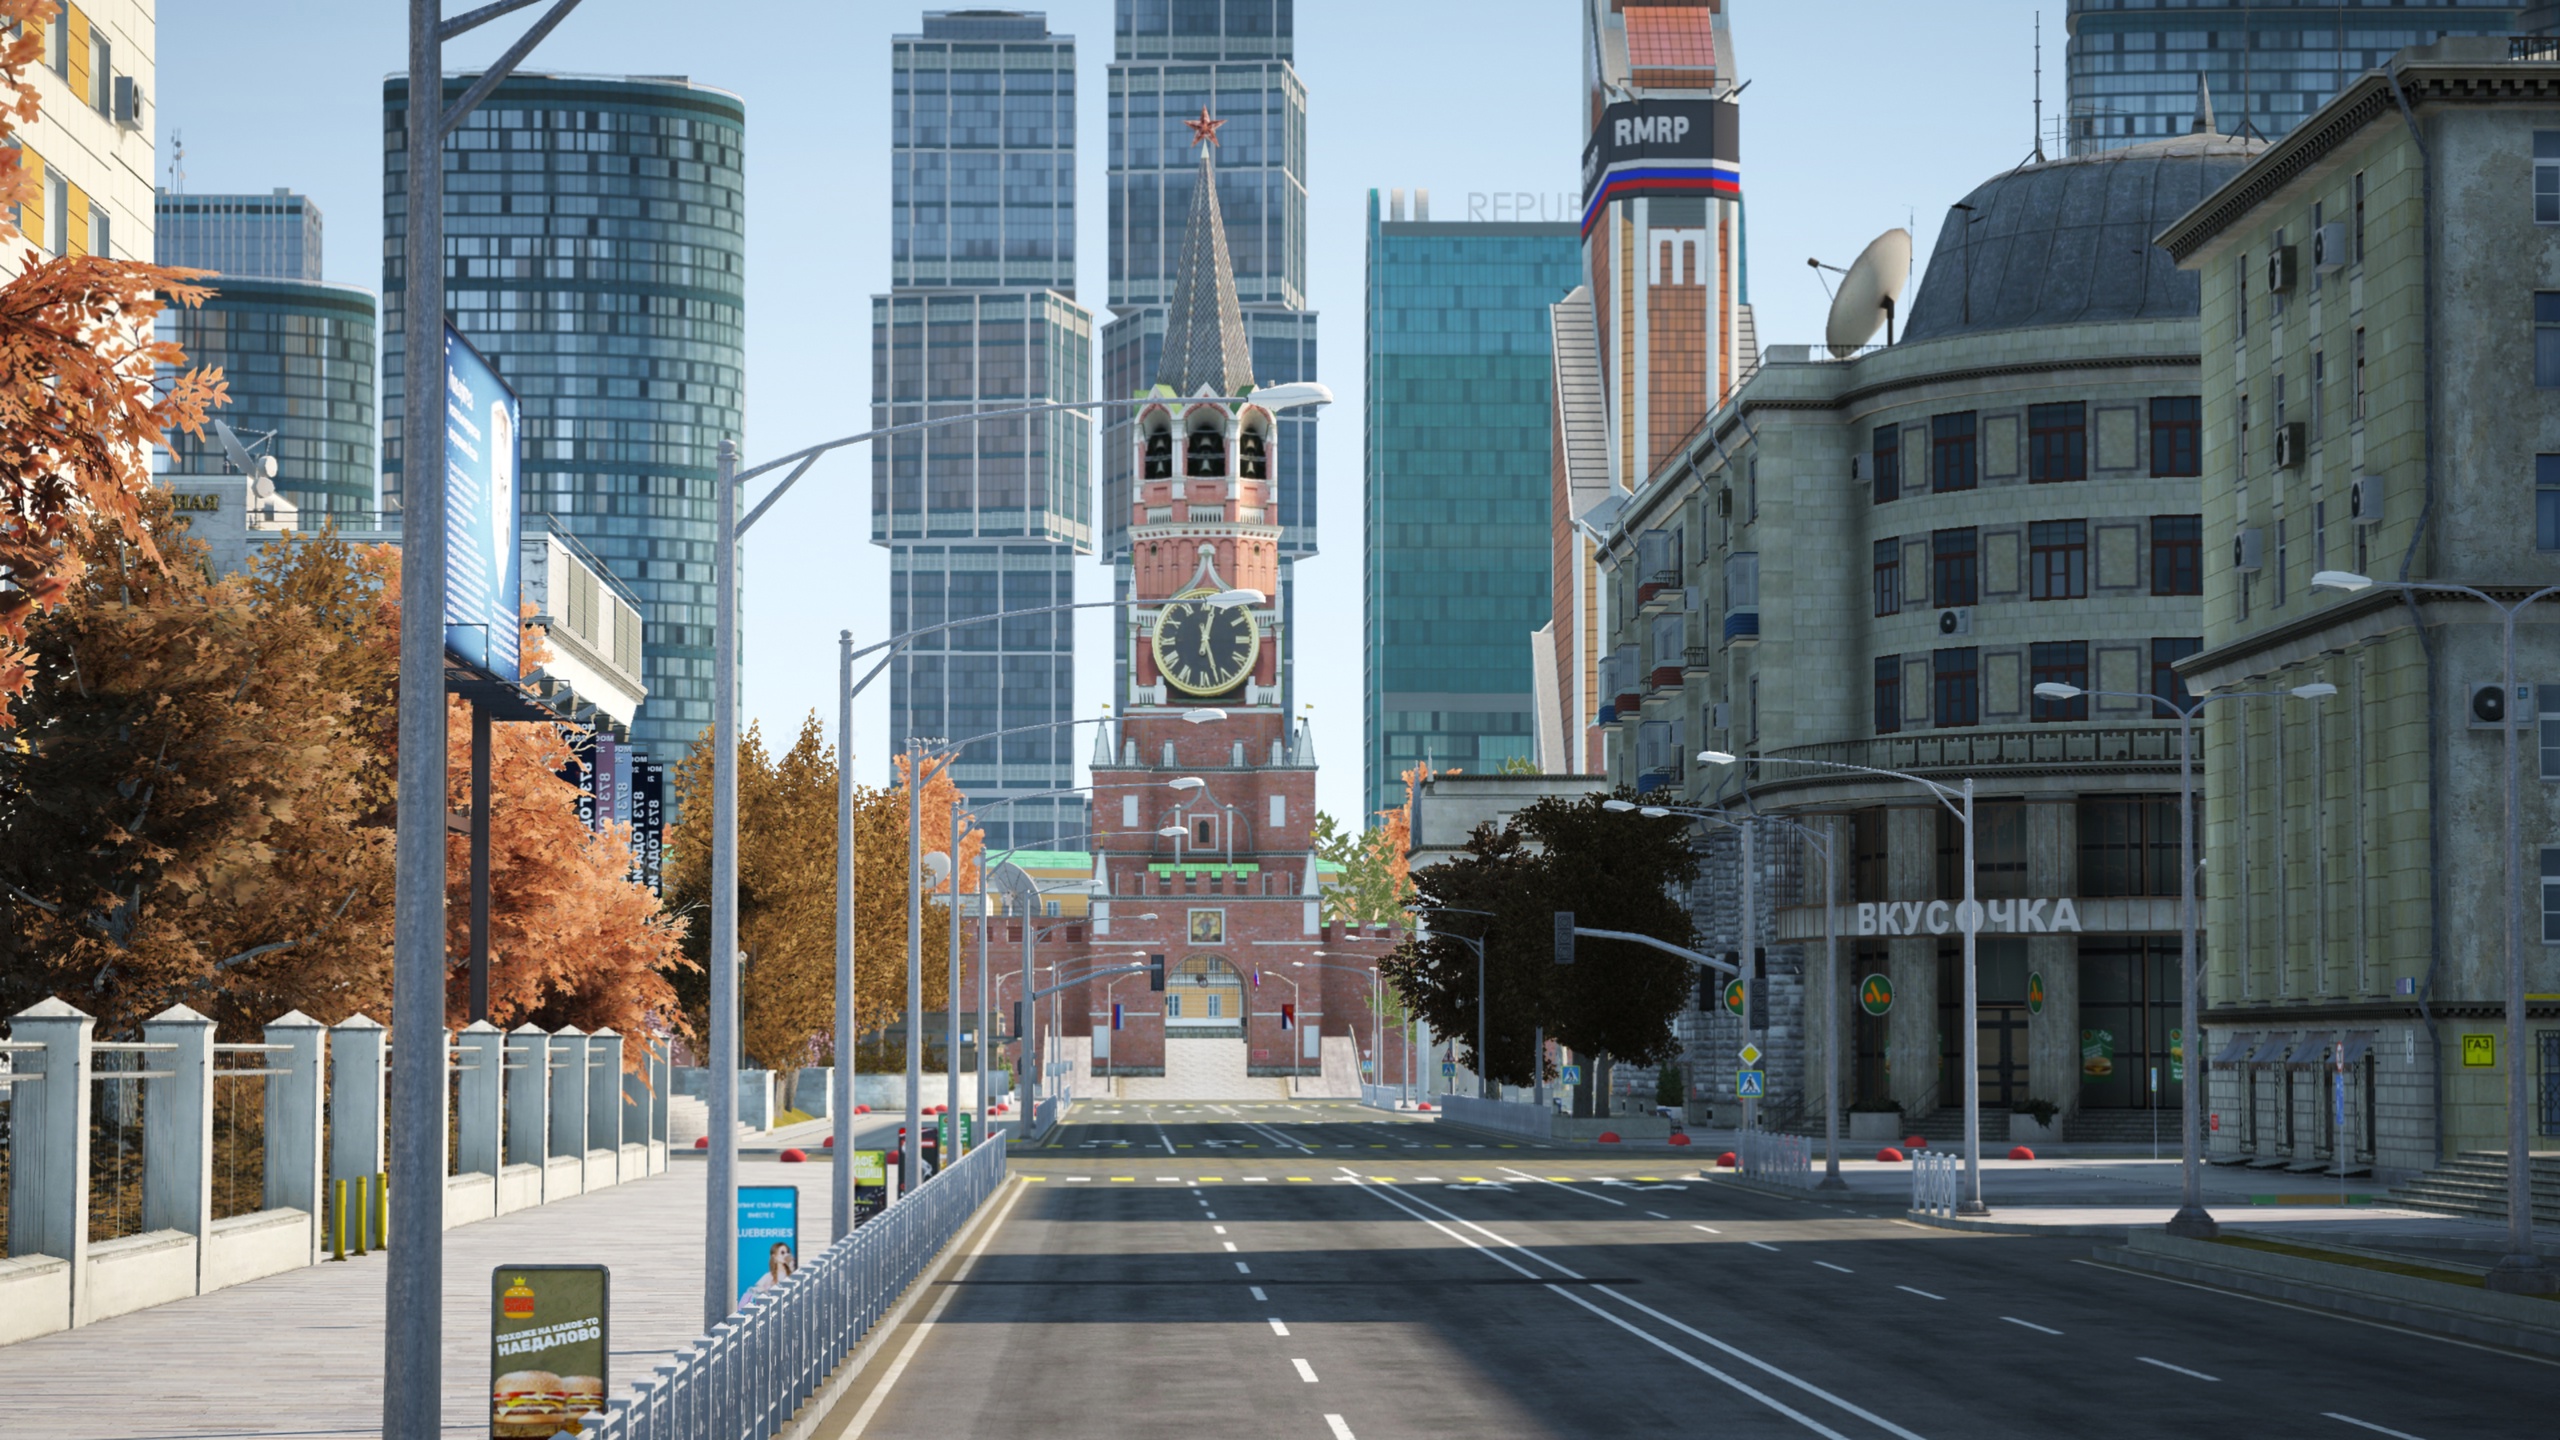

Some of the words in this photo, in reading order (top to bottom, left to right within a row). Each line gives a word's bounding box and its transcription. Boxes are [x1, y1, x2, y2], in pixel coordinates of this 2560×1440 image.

[1614, 116, 1690, 146] RMRP
[1467, 192, 1582, 222] REPUB
[172, 494, 220, 511] НАЯ
[1858, 898, 2082, 936] ВКУСОЧКА
[2467, 1039, 2490, 1049] ГАЗ
[854, 1155, 874, 1167] АФЕ
[737, 1228, 793, 1238] LUEBERRIES
[496, 1328, 537, 1343] ПОХОЖЕ
[537, 1326, 552, 1335] НА
[552, 1317, 599, 1332] КАКОЕ-ТО
[497, 1326, 601, 1357] НАЕДАЛОВО
